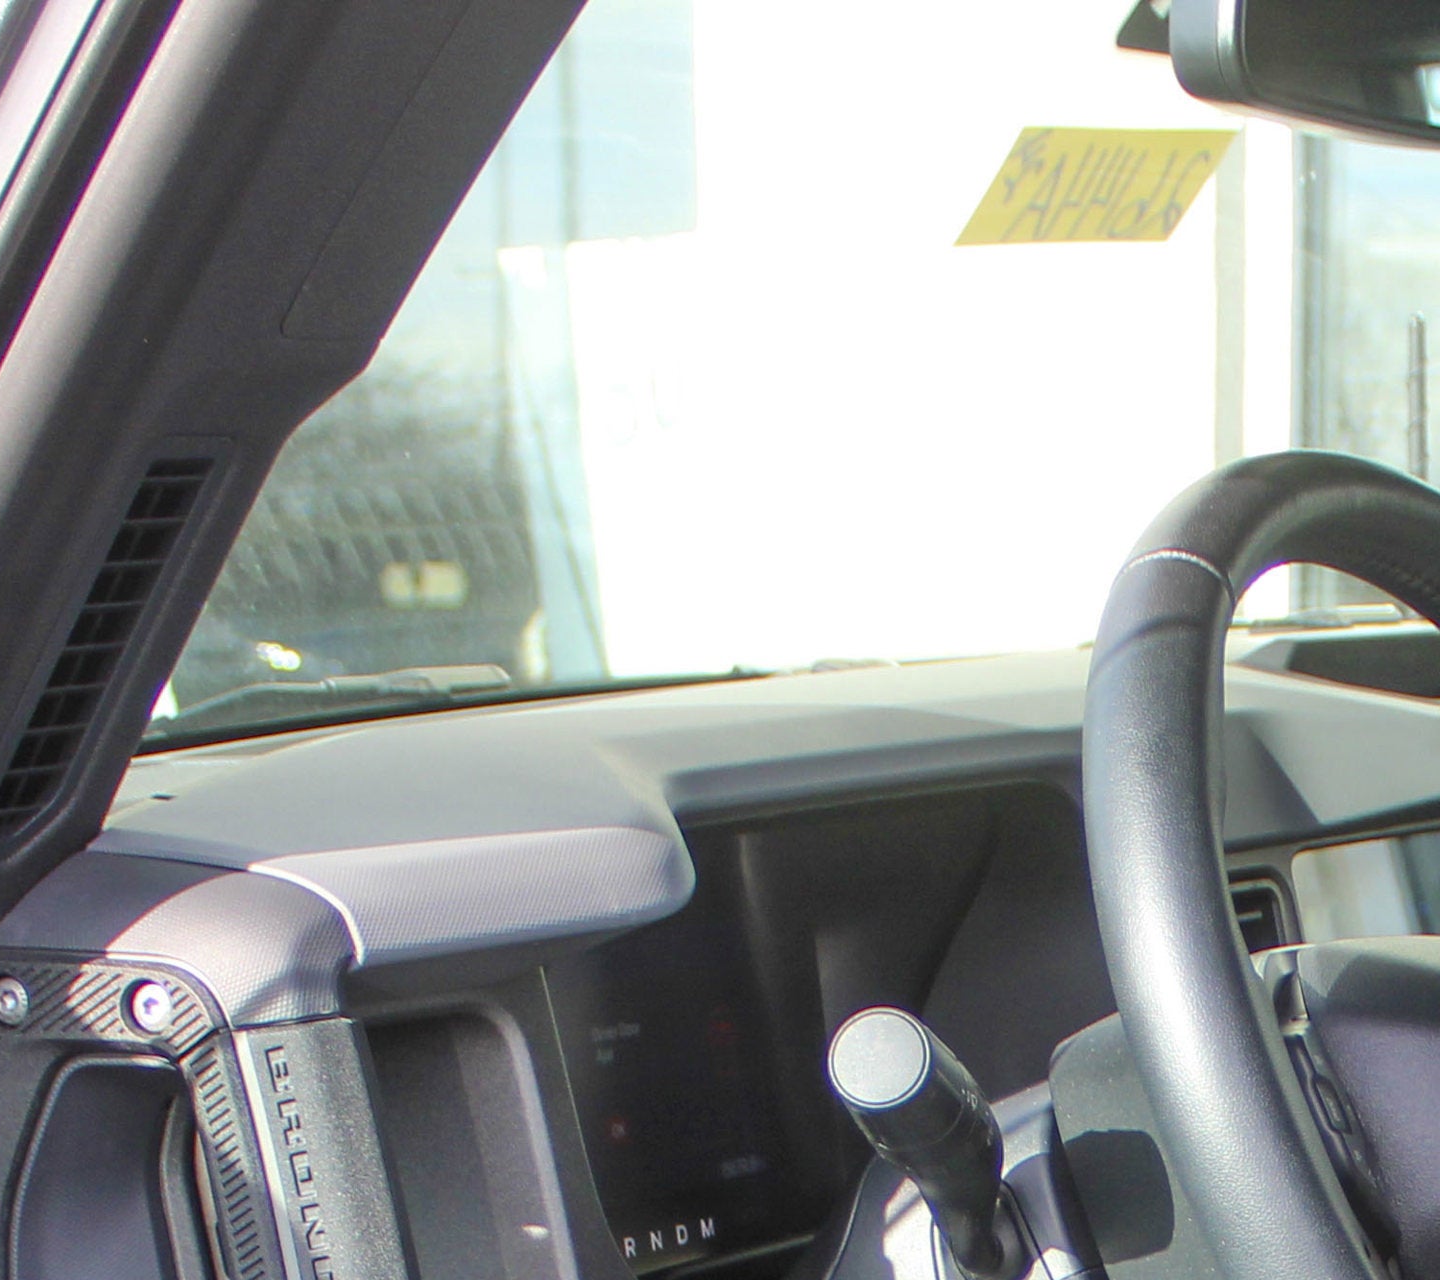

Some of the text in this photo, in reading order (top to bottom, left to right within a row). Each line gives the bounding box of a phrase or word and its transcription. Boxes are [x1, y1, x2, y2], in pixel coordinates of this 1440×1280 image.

[623, 1217, 716, 1258] R N D M
